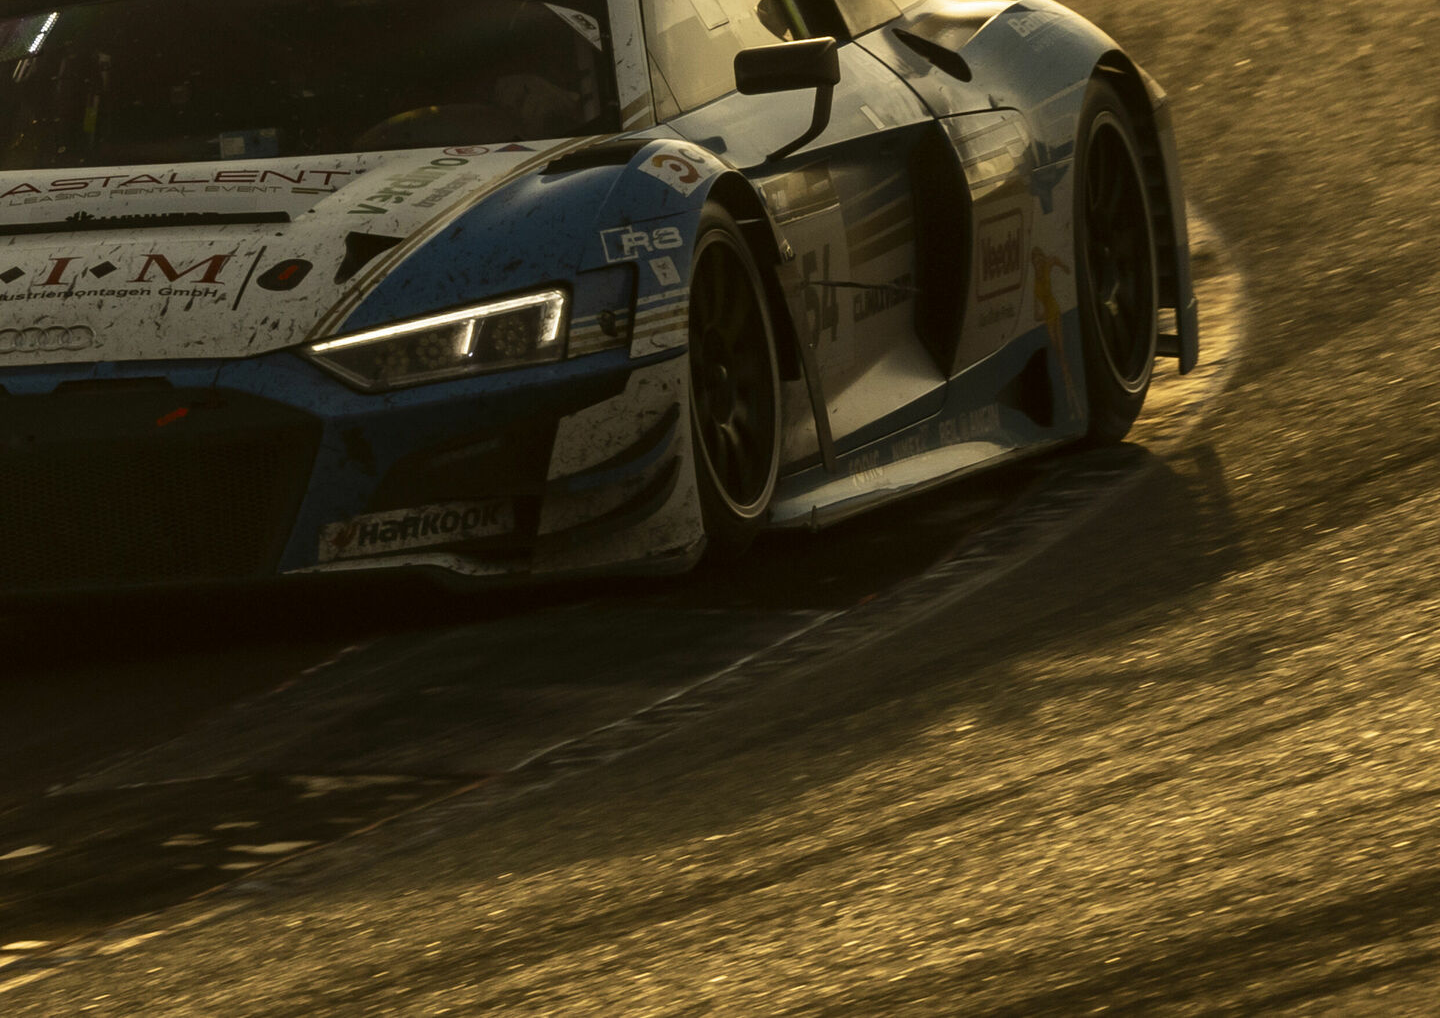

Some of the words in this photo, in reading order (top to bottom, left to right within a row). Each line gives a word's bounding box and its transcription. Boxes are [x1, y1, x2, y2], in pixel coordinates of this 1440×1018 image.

[9, 189, 101, 207] LEASING
[110, 185, 198, 200] RENTAL
[205, 184, 283, 194] EVENT
[621, 226, 684, 252] R8
[158, 285, 218, 299] GmbH
